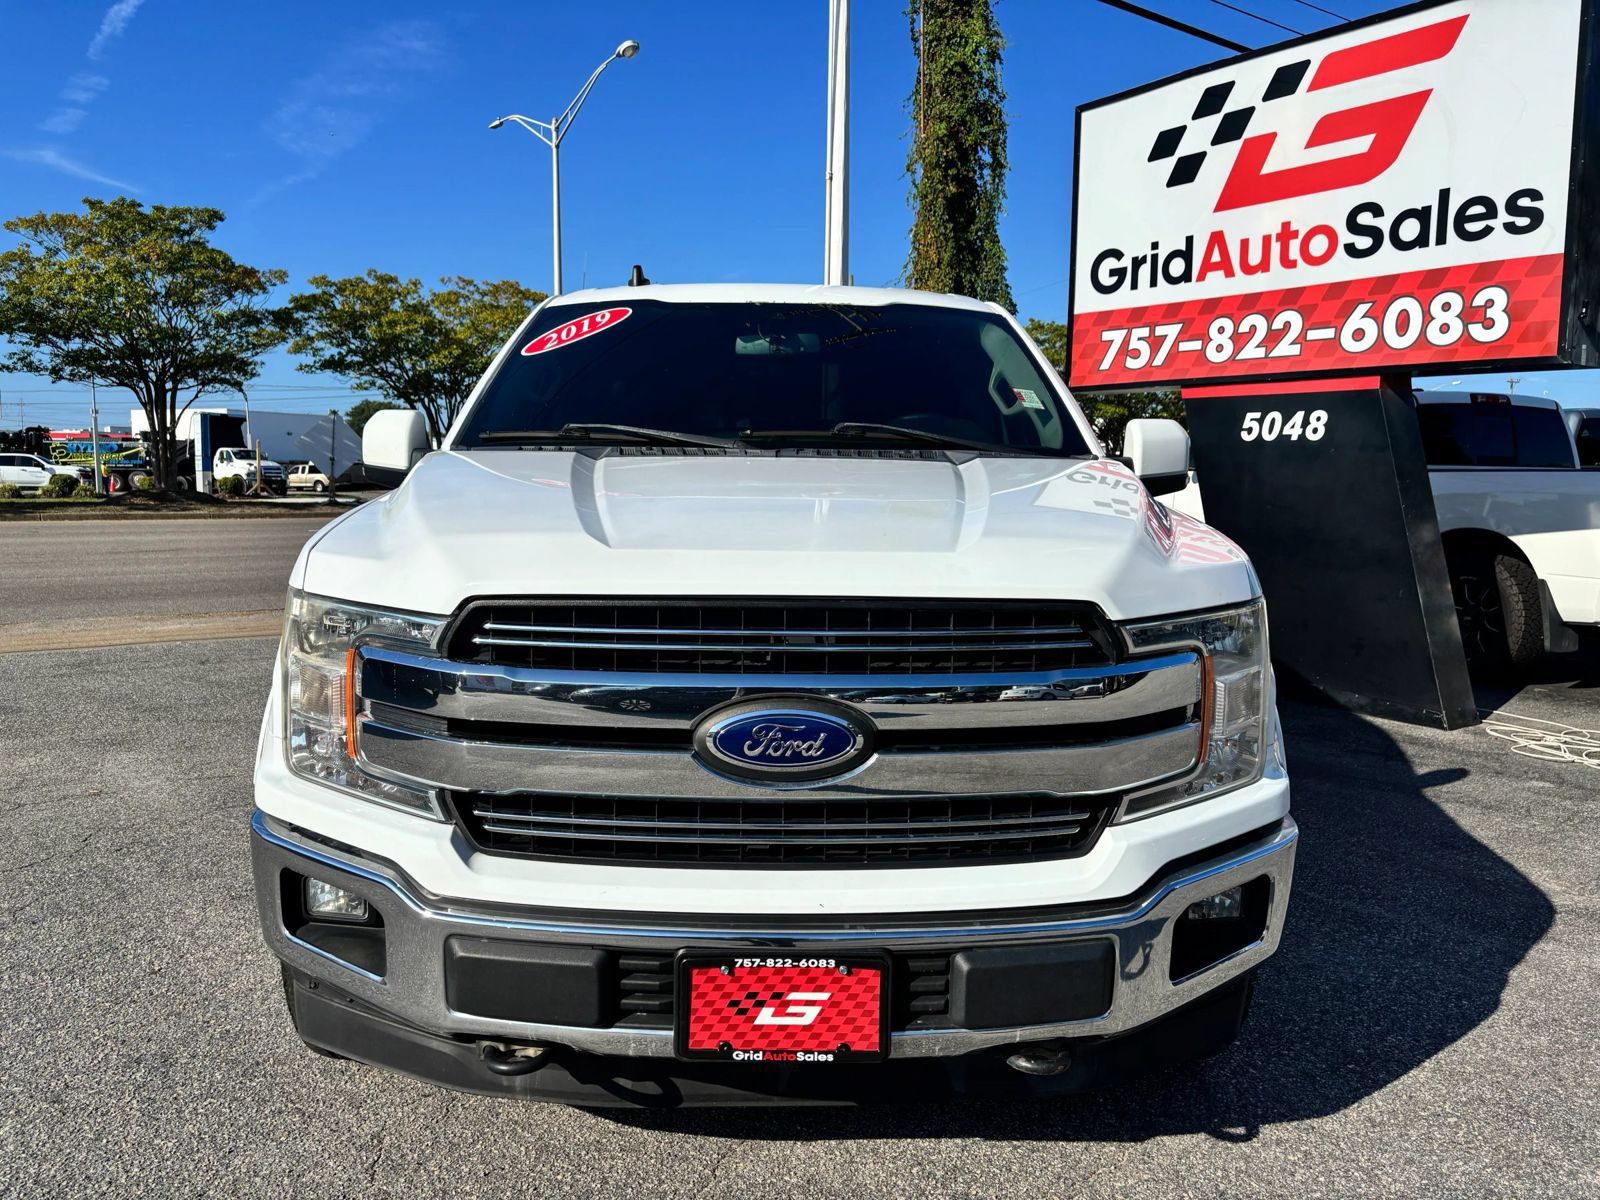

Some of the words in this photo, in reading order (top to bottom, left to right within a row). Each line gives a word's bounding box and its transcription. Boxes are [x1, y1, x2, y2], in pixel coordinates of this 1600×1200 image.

[1090, 187, 1545, 296] GridAutoSales
[544, 311, 611, 350] 2019
[1097, 284, 1512, 372] 757-822-6083
[1240, 409, 1329, 442] 5048
[743, 723, 828, 757] Ford
[734, 958, 836, 968] 757-822-6083
[732, 1050, 834, 1062] GridAutoSales
